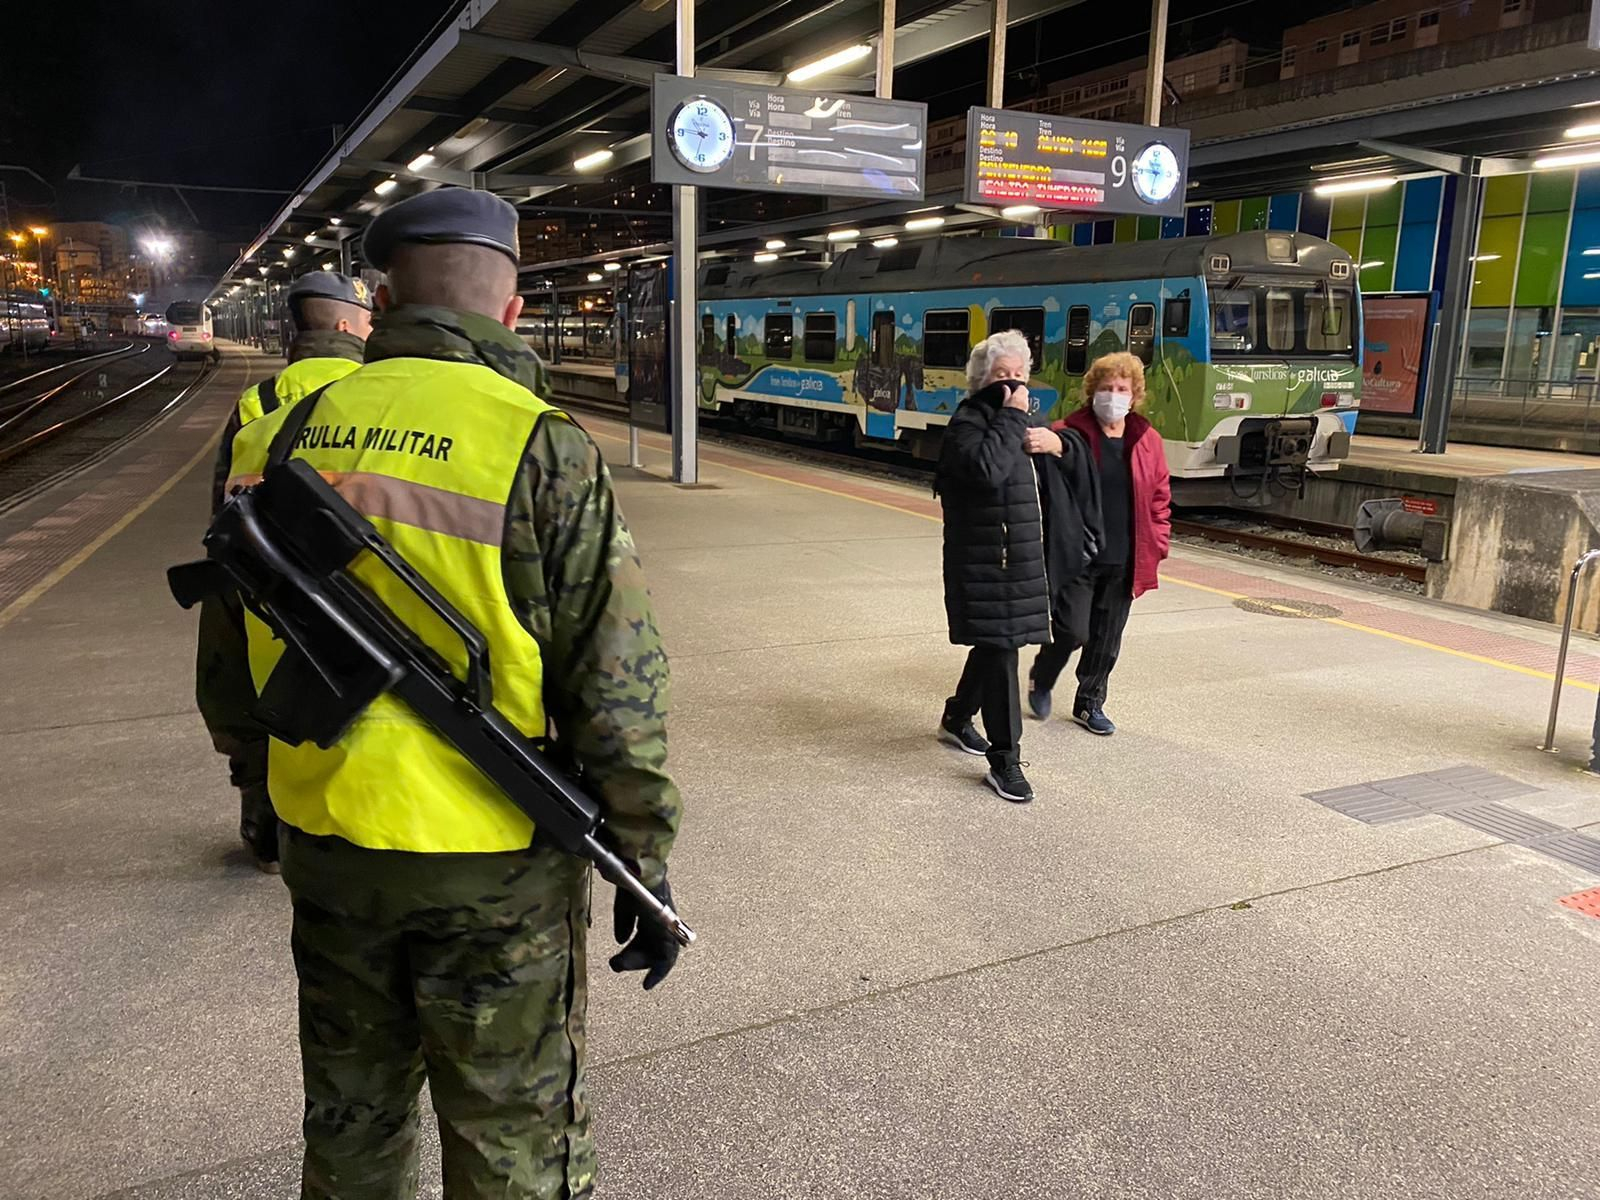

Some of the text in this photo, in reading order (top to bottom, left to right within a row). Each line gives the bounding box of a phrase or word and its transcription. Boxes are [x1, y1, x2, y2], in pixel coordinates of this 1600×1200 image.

[767, 93, 785, 103] Hora
[767, 102, 785, 112] Hora
[981, 113, 996, 122] Hora
[981, 121, 996, 130] Hora
[1039, 120, 1052, 129] Tren
[1039, 128, 1052, 136] Tren
[745, 124, 764, 161] 7
[767, 138, 796, 147] Destino
[980, 146, 1003, 155] Destino
[980, 154, 1004, 163] Destino
[1111, 155, 1127, 188] 9
[1286, 366, 1340, 391] galicia
[296, 425, 454, 462] RULLA MILITAR
